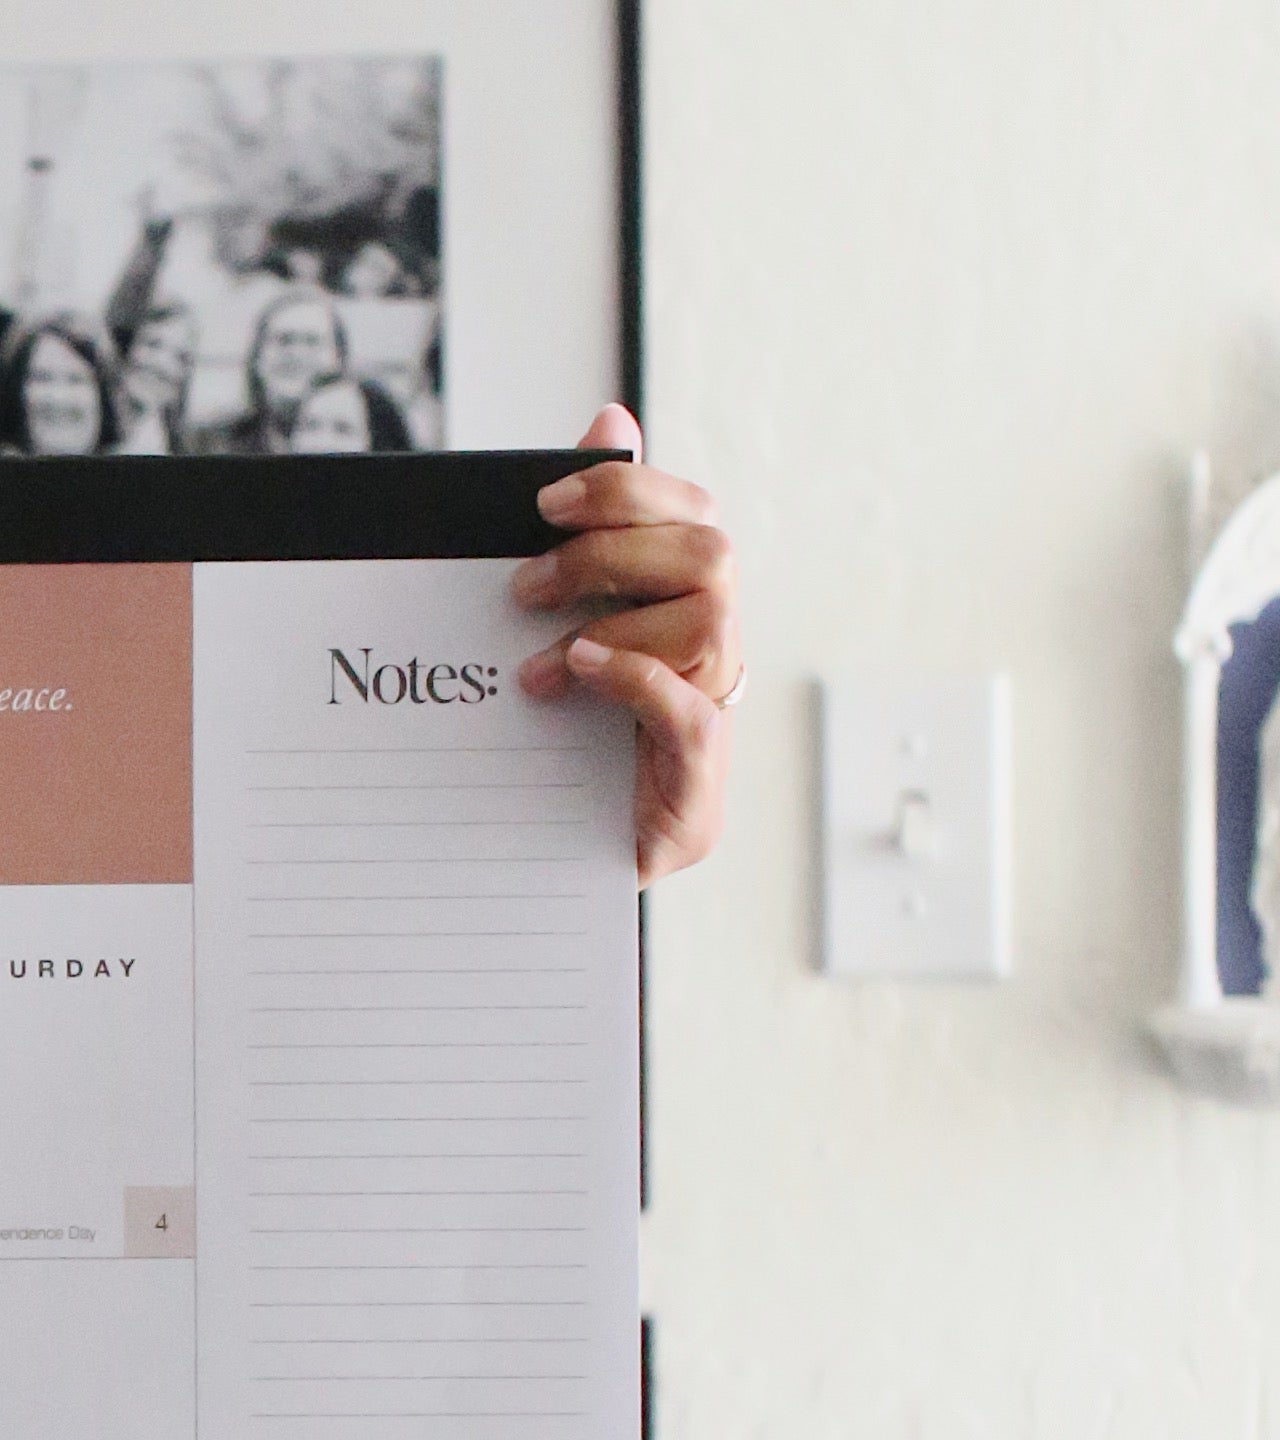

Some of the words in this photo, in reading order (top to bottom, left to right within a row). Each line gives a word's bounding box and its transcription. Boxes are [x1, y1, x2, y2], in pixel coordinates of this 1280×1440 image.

[328, 647, 499, 706] Notes:
[154, 1213, 169, 1232] 4
[68, 1225, 96, 1243] Day
